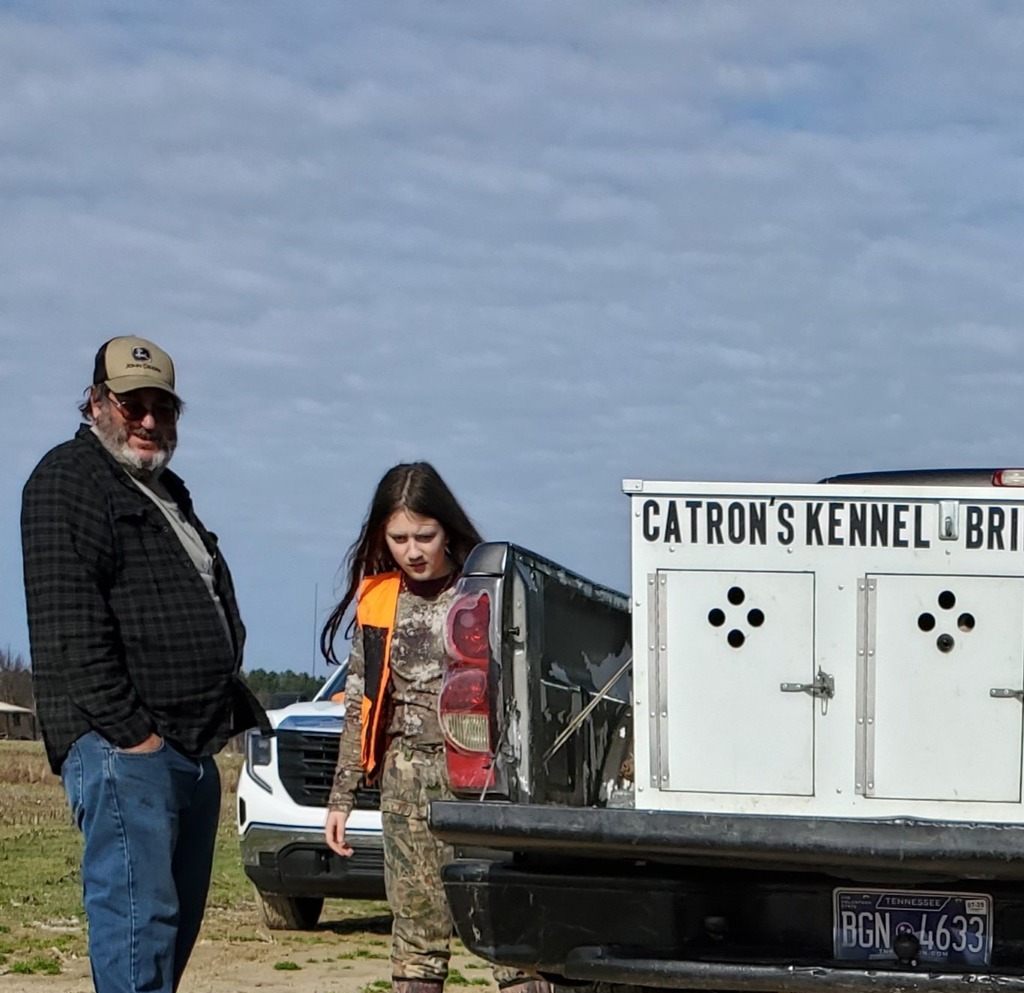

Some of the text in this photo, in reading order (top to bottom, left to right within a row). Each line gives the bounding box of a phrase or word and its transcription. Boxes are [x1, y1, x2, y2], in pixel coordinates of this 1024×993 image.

[642, 496, 795, 546] CATRON'S
[806, 502, 931, 549] KENNEL
[885, 896, 942, 907] TENNESSEE
[841, 911, 985, 953] BGN 4633
